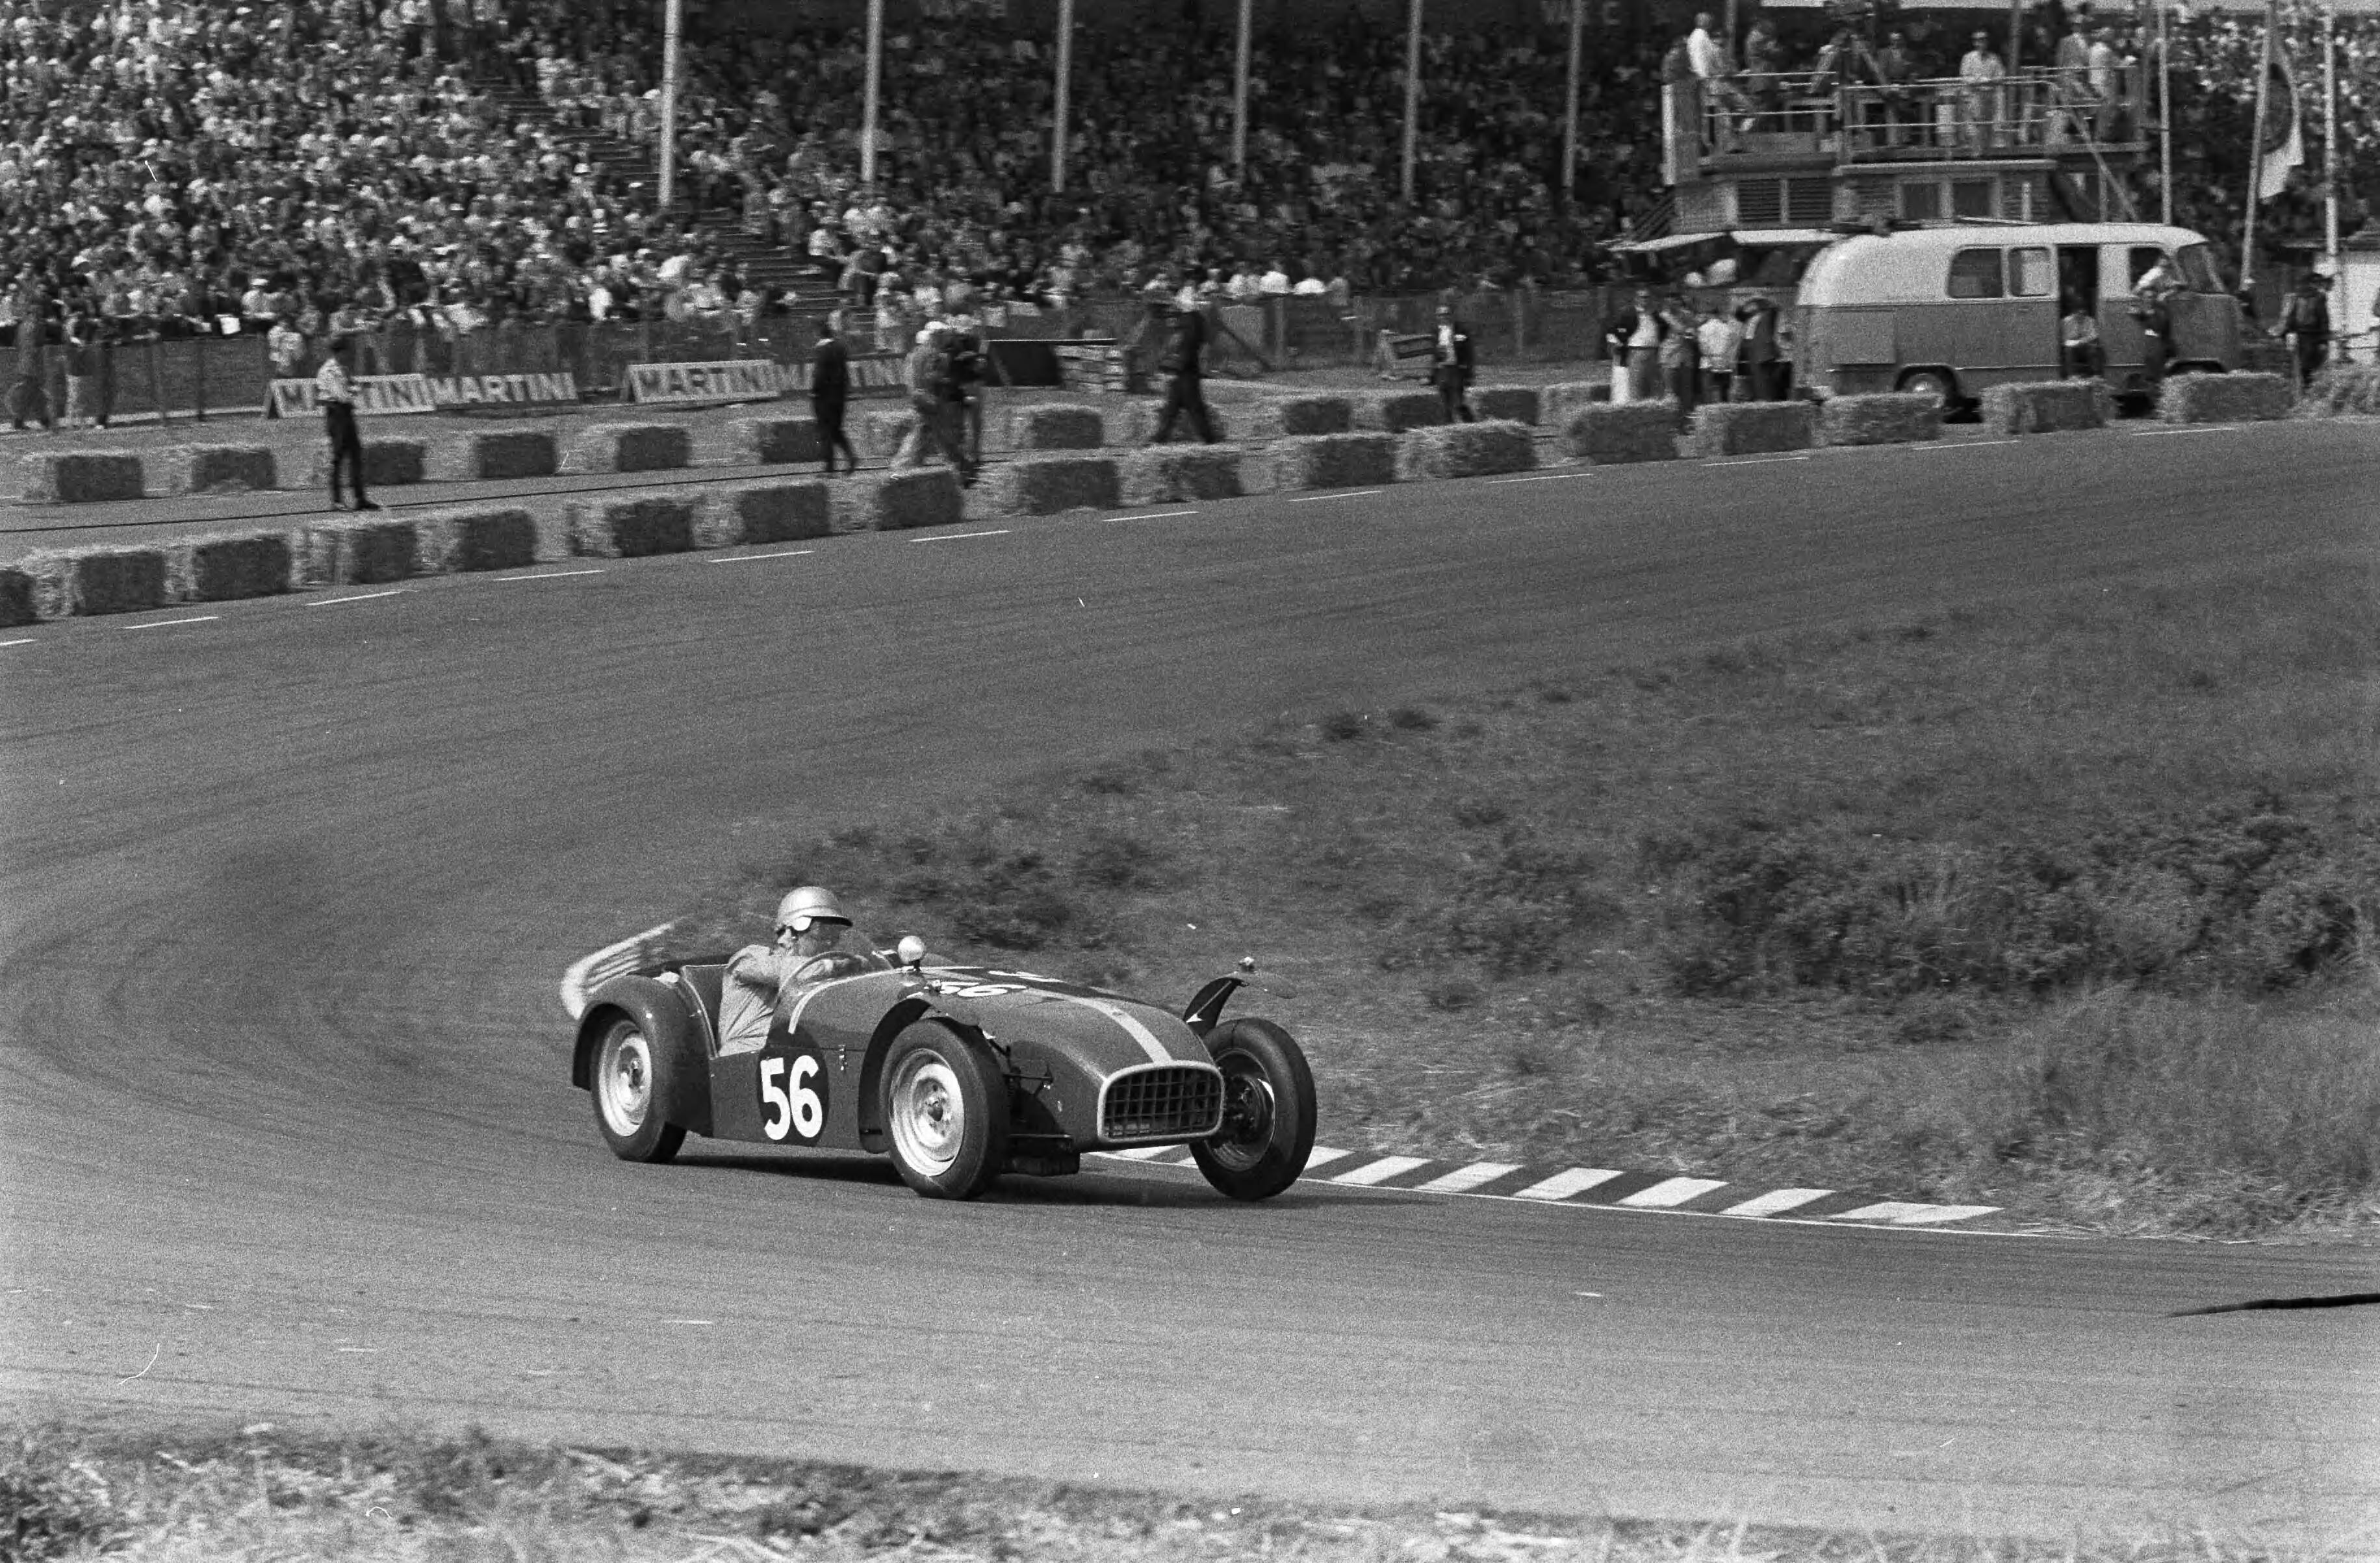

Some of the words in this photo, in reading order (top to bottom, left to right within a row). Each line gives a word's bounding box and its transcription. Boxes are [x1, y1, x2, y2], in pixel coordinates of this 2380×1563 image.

[428, 372, 578, 405] MARTINI
[637, 365, 774, 396] MARTINI
[773, 359, 911, 390] MTINI
[279, 378, 426, 411] MTINI
[940, 981, 1027, 998] 56
[760, 1054, 823, 1141] 56
